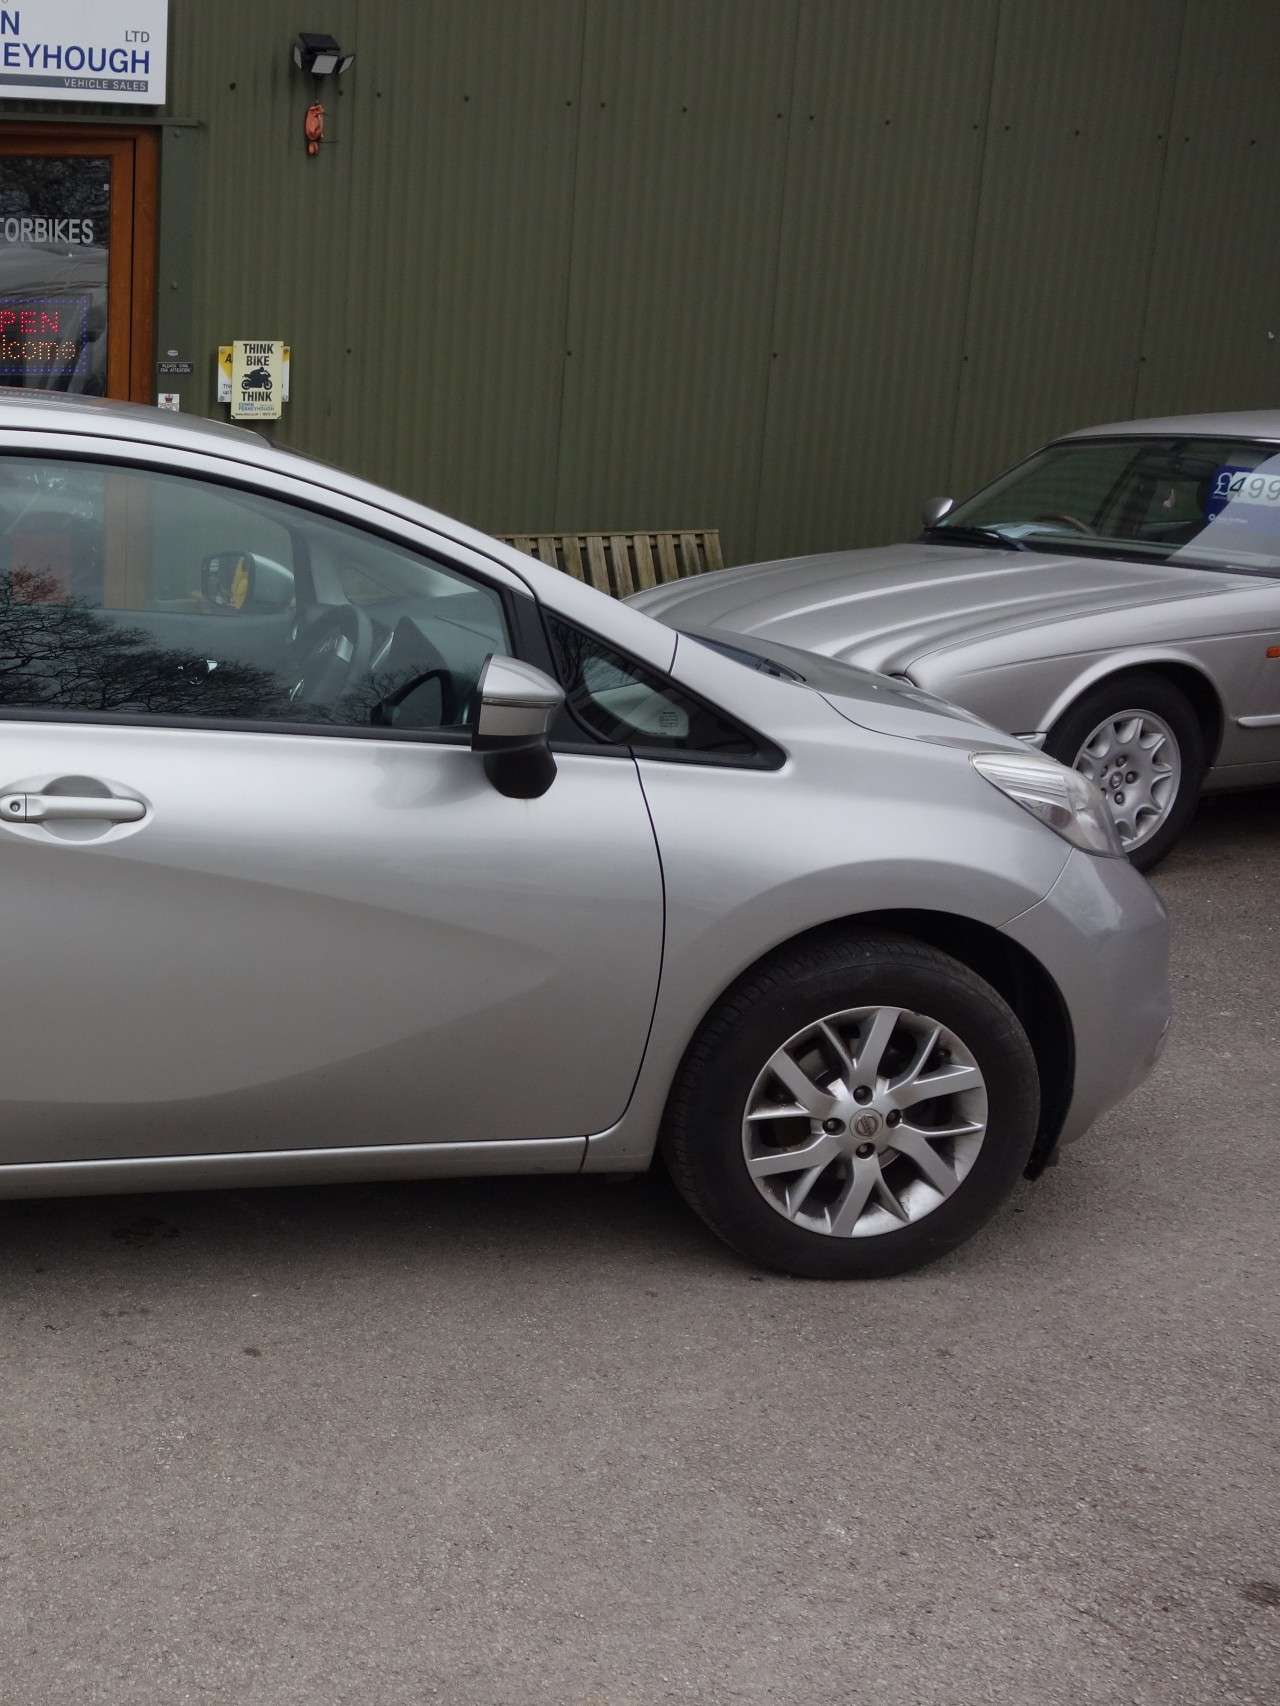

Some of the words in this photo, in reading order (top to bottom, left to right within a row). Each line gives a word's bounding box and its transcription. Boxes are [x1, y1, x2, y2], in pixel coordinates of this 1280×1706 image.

[124, 30, 150, 43] LTD
[64, 78, 109, 89] VEHICLE
[112, 80, 146, 91] SALES
[243, 343, 274, 355] THINK
[246, 355, 270, 366] BIKE
[241, 391, 273, 402] THINK
